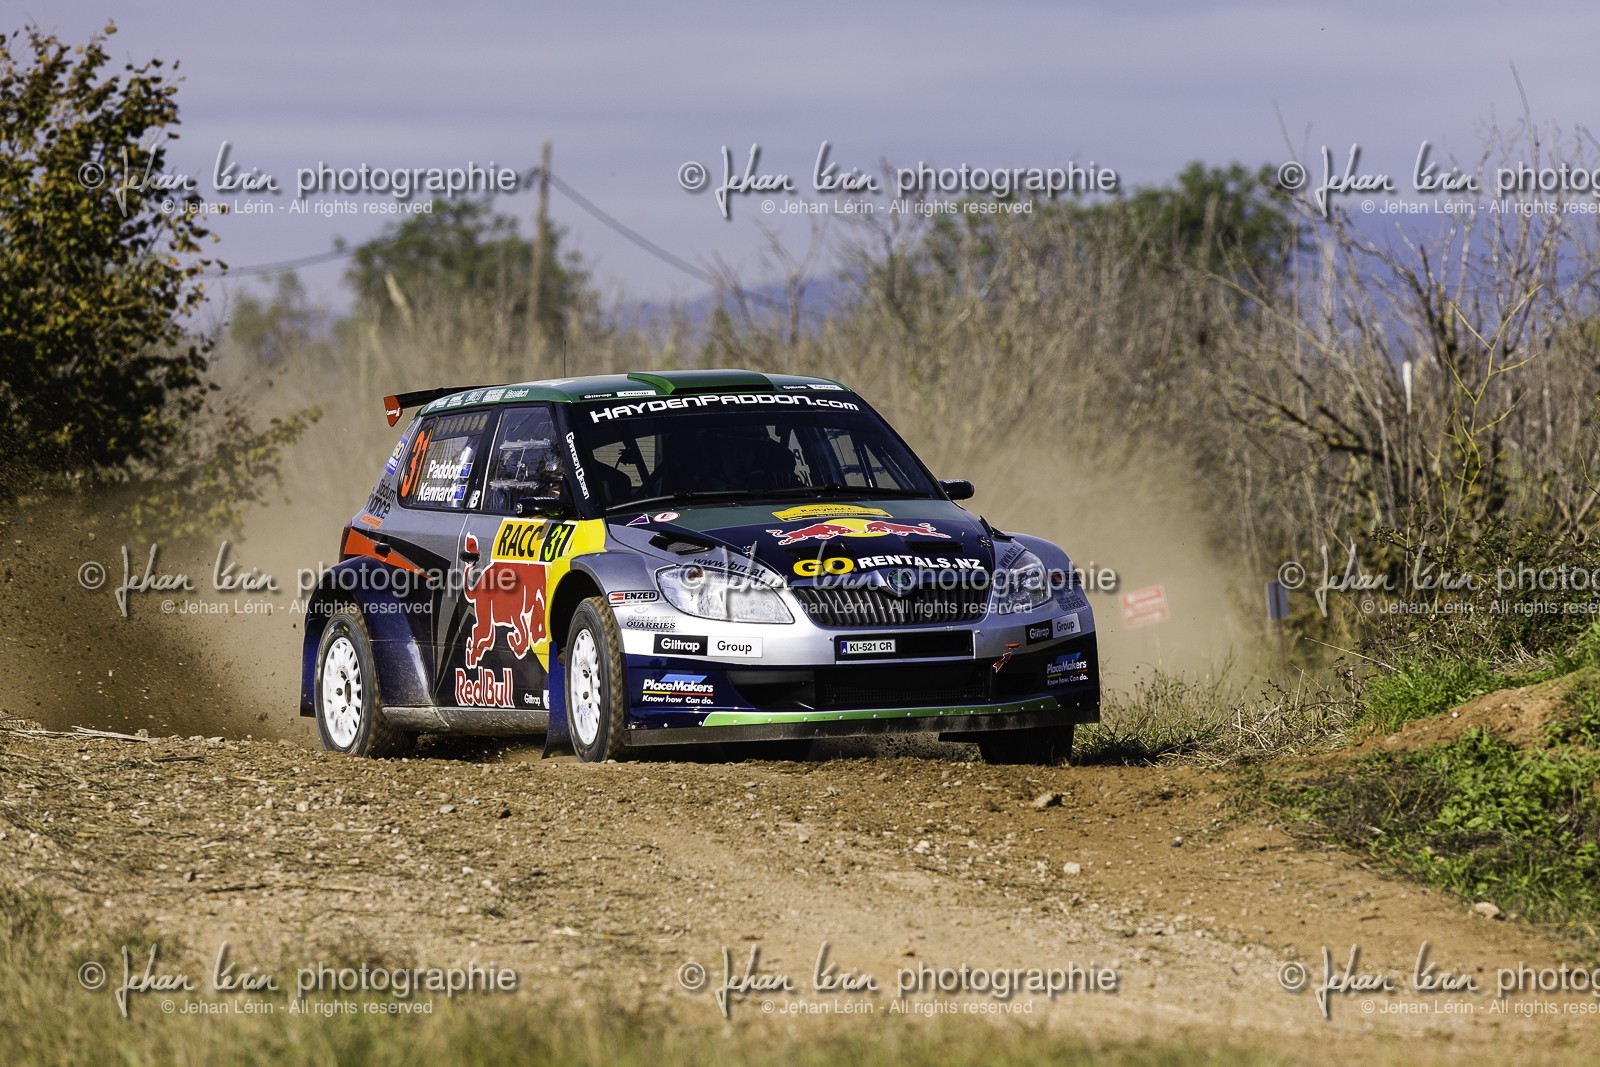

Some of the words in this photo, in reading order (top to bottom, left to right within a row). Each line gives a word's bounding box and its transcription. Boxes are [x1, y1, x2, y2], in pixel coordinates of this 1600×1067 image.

[401, 429, 432, 498] 31
[417, 481, 457, 502] Kennard
[497, 524, 544, 558] RACC
[544, 525, 571, 561] 31
[793, 557, 855, 577] GO
[857, 555, 985, 570] RENTALS.NZ
[624, 592, 656, 600] ENZED
[626, 620, 676, 629] QUARRIES
[1029, 627, 1050, 639] Giltrap
[1056, 620, 1075, 632] Group
[661, 638, 700, 653] Giltrap
[717, 640, 752, 655] Group
[849, 642, 877, 652] KI-521
[879, 641, 893, 651] CR
[1046, 659, 1088, 675] PlaceMakers
[455, 668, 483, 707] Red
[483, 668, 514, 708] Bull
[642, 678, 714, 693] PlaceMakers
[642, 695, 664, 703] Know
[685, 696, 700, 704] Can
[701, 696, 714, 705] do.
